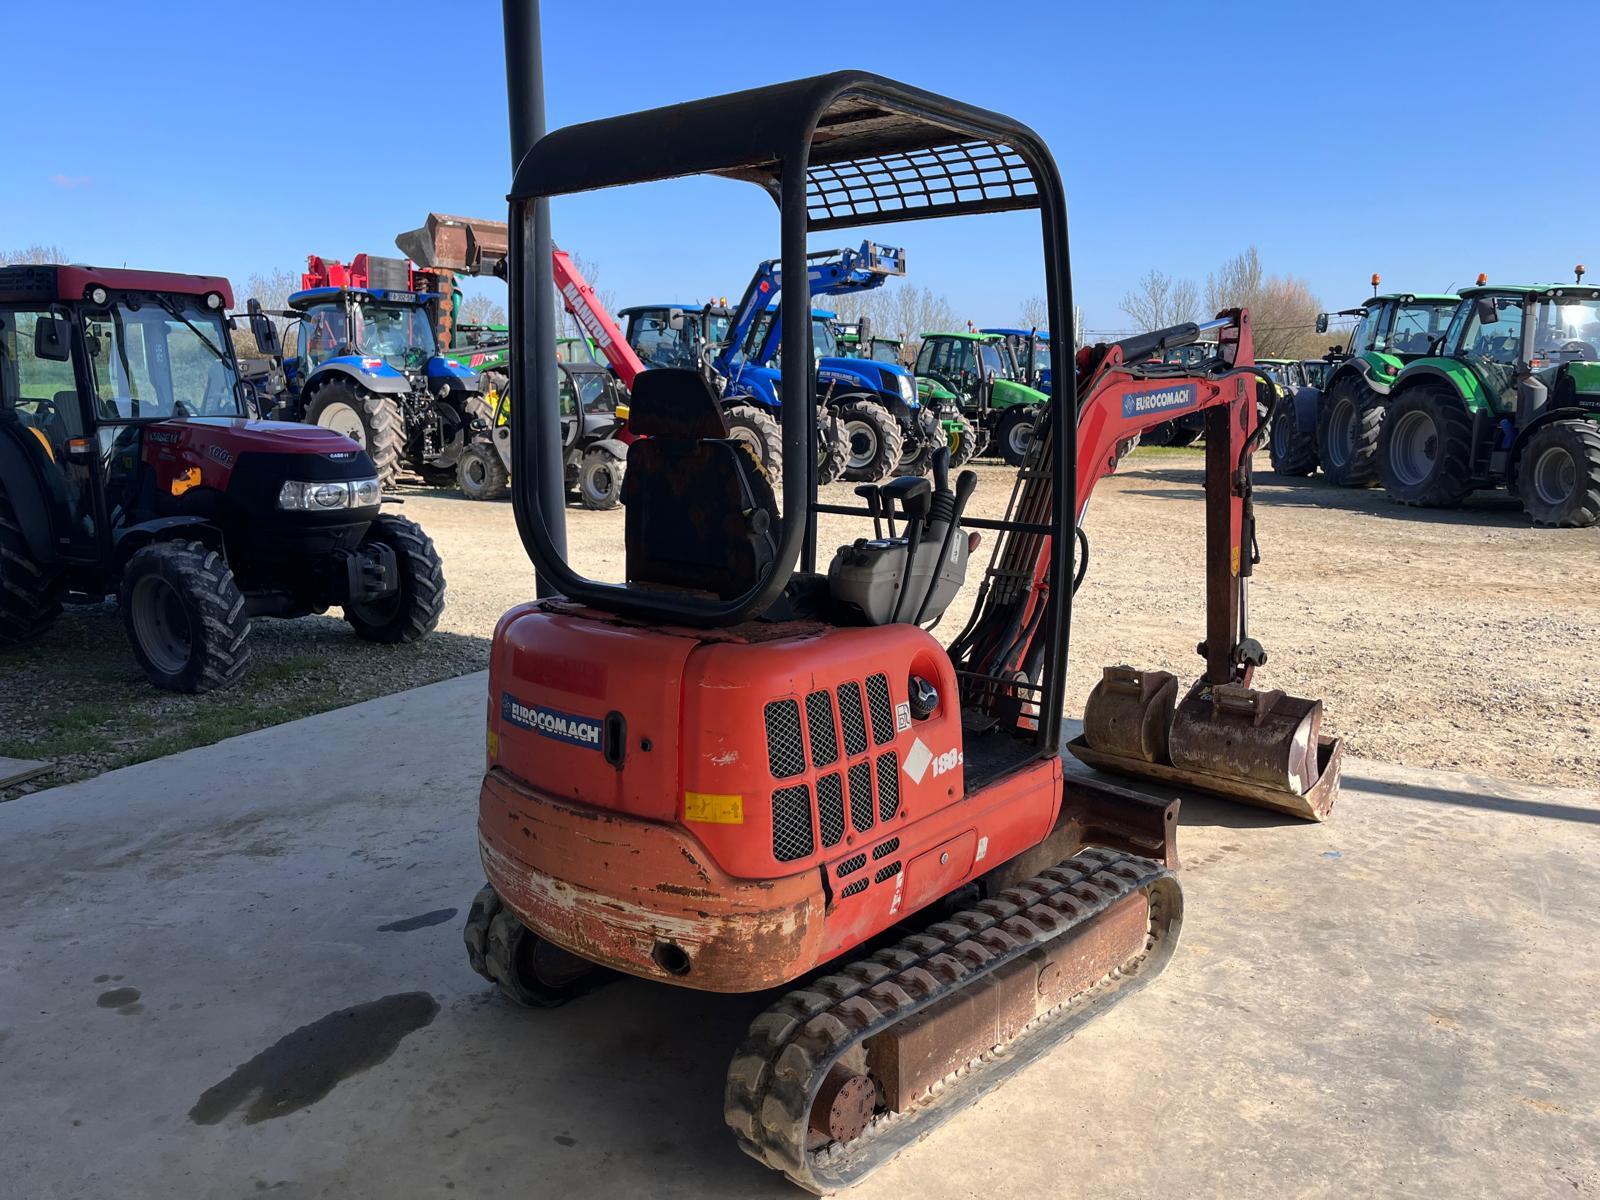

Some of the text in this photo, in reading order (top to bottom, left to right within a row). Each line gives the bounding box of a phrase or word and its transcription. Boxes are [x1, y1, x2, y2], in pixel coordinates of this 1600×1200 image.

[563, 282, 611, 348] MANITOU
[1135, 390, 1189, 411] EUROCOMACH
[511, 702, 599, 744] EUROCOMACH
